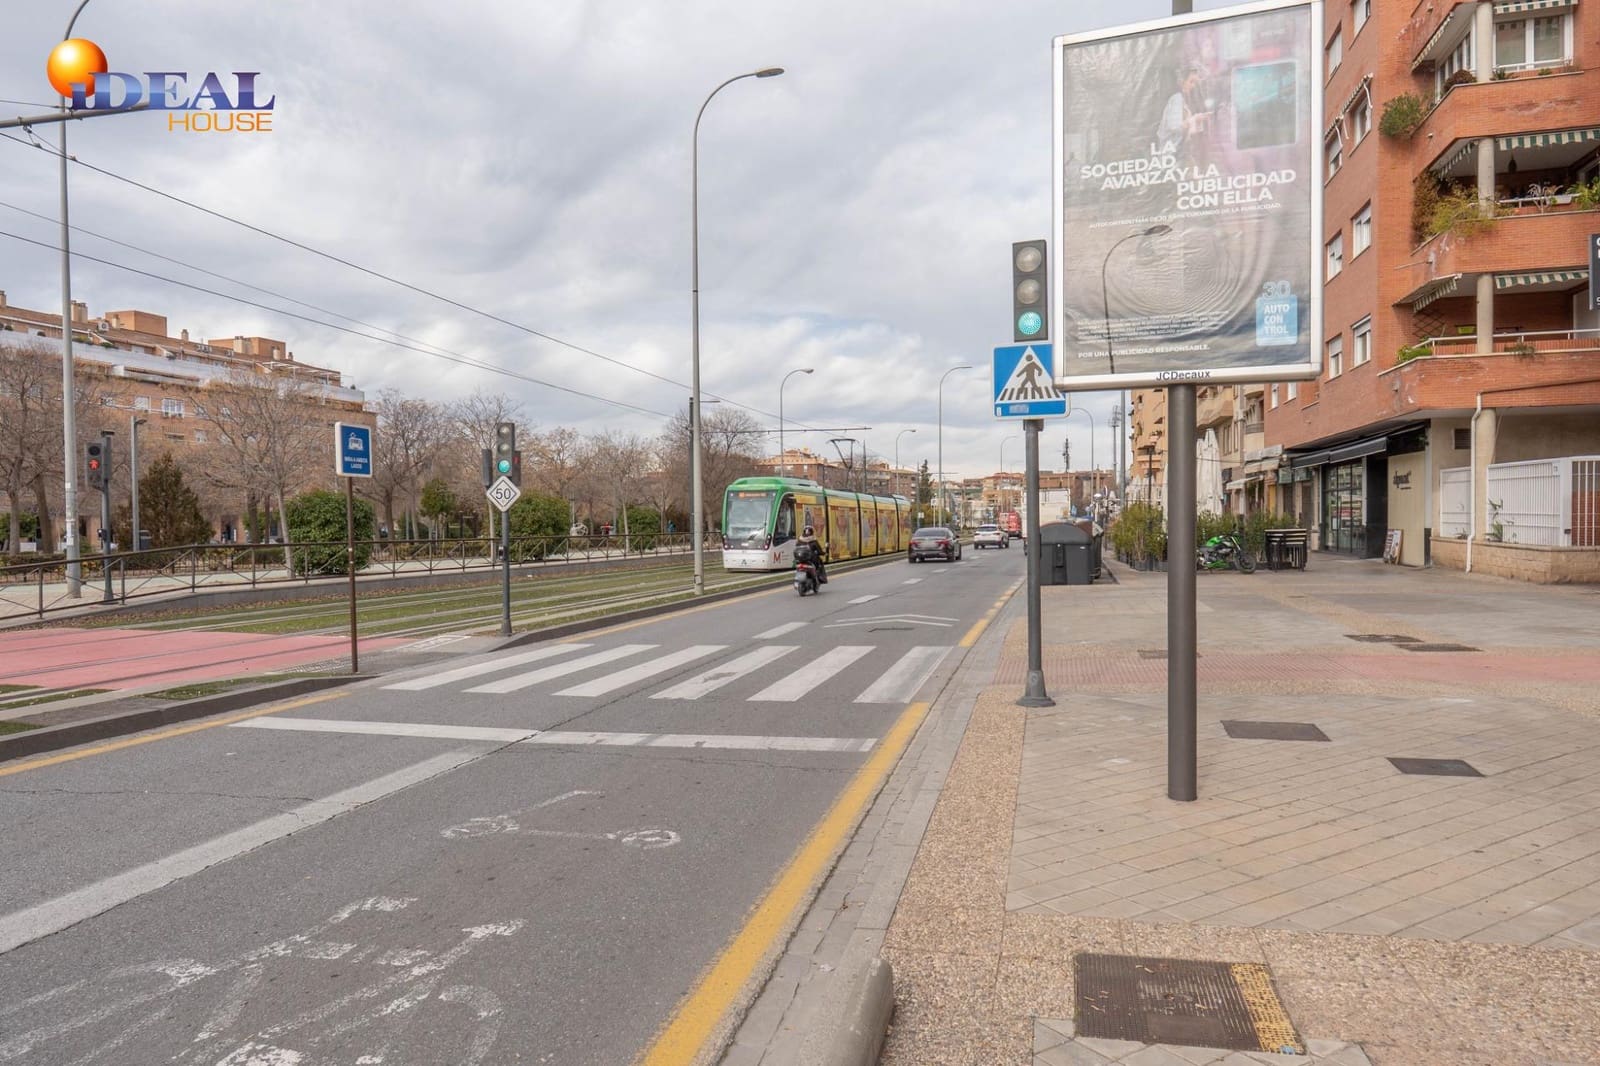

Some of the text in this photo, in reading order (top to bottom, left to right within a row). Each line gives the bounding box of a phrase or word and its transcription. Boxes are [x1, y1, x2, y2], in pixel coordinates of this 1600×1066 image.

[1150, 142, 1177, 156] LA
[1080, 155, 1177, 180] SOCIEDAD
[1101, 163, 1220, 191] AVANZA Y LA
[1177, 169, 1296, 196] PUBLICIDAD
[1177, 187, 1273, 210] CON ELLA
[1263, 280, 1290, 300] 30
[1264, 304, 1290, 315] AUTO
[1264, 314, 1284, 325] CON
[1264, 325, 1289, 336] TROL
[1094, 350, 1109, 358] UNA
[1111, 346, 1153, 356] PUBLICIDAD
[1156, 370, 1211, 381] JCDecaux
[495, 487, 511, 500] 50
